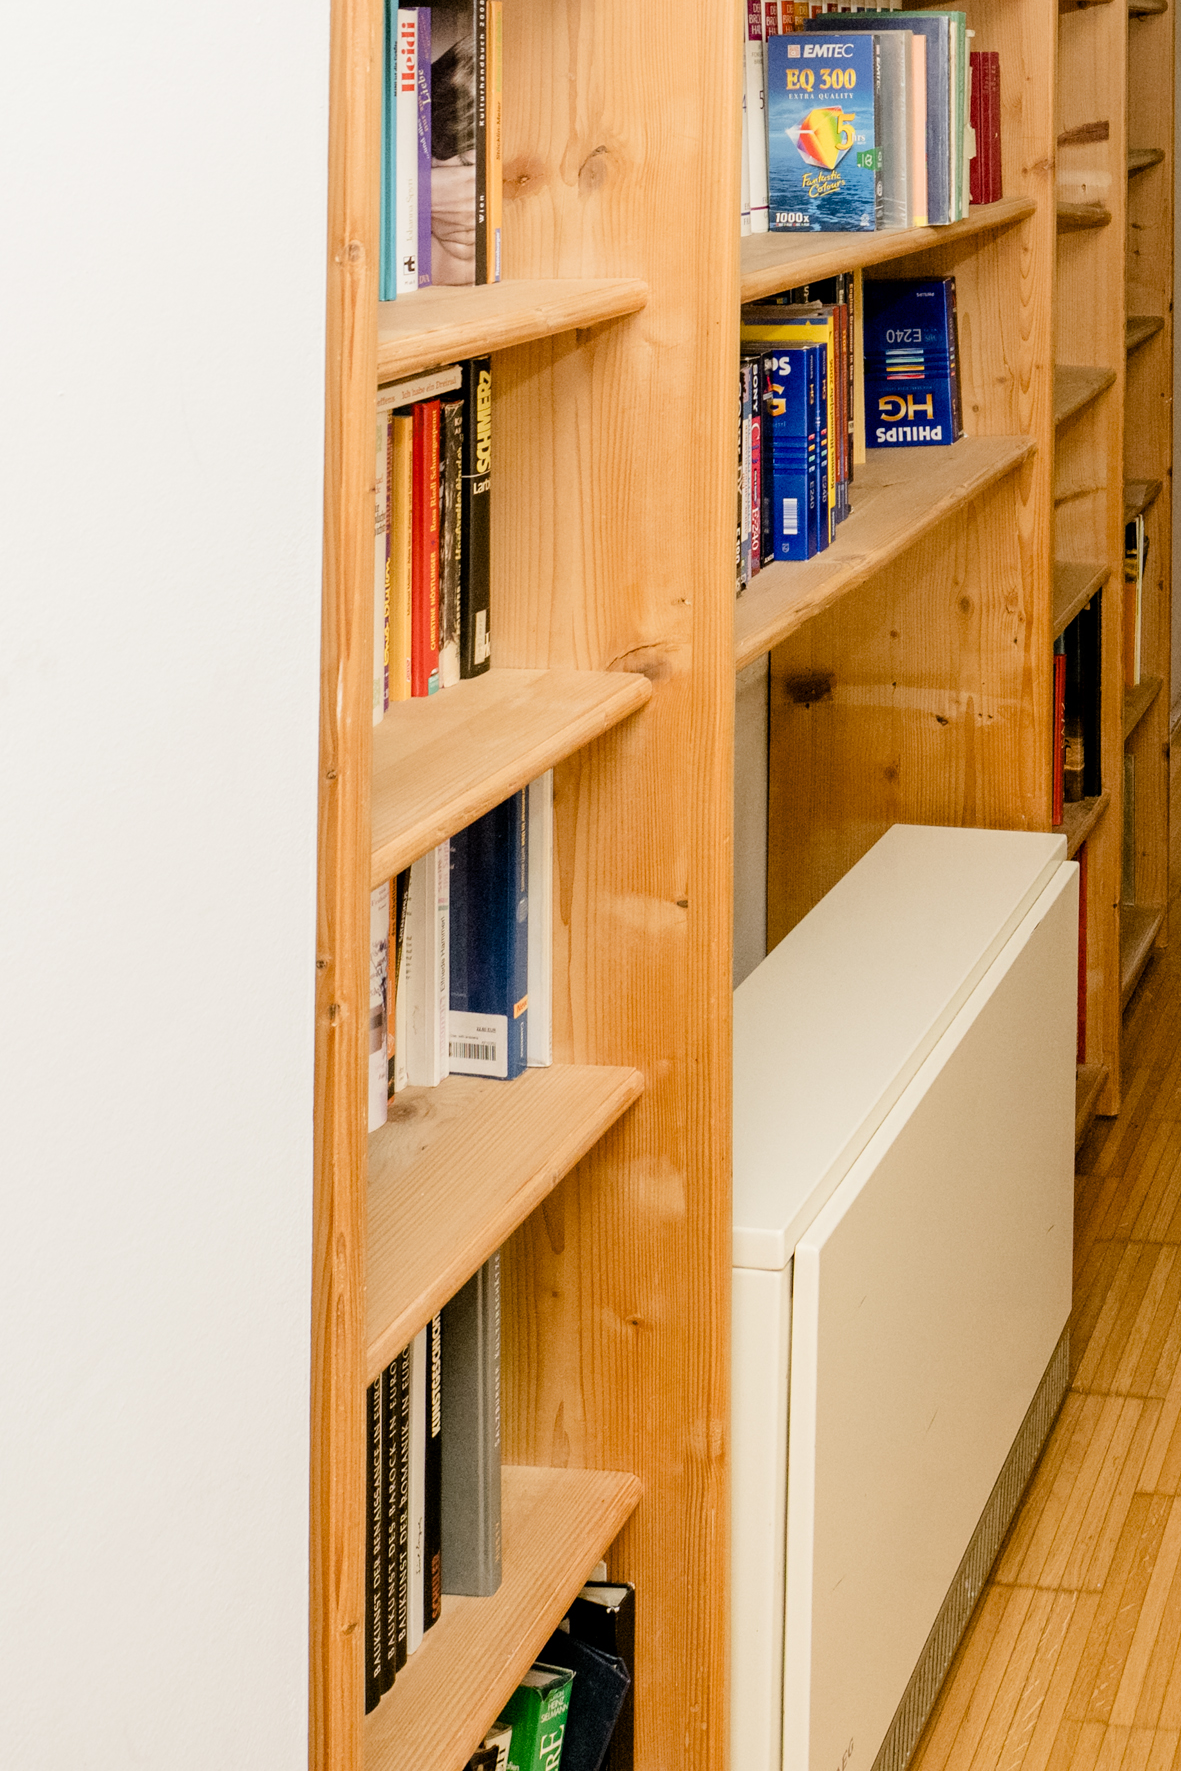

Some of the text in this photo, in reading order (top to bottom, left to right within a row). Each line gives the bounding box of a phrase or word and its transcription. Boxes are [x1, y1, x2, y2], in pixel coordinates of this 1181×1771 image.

[400, 22, 415, 92] Heidi
[803, 44, 854, 58] EMTEC
[418, 69, 431, 105] Liebe
[786, 68, 856, 92] EQ 300
[818, 92, 854, 100] QUALITY
[834, 112, 856, 150] 5
[802, 170, 841, 188] Fantastic
[808, 180, 846, 198] Colours
[776, 212, 810, 223] 1000x
[886, 328, 922, 343] E240
[402, 390, 411, 400] Ich
[426, 383, 435, 392] ein
[435, 376, 457, 389] Dreirad
[476, 370, 491, 473] SCHMERZ
[878, 393, 934, 422] HG
[430, 410, 438, 480] Schutzgespenst
[876, 426, 942, 442] PHILIPS
[400, 1394, 409, 1416] IN
[373, 1423, 380, 1443] IN
[389, 1415, 397, 1438] IN
[388, 1442, 396, 1516] BAROCK
[399, 1422, 409, 1508] ROMANIK
[373, 1449, 382, 1555] RENAISSANCE
[388, 1522, 396, 1558] DES
[399, 1510, 408, 1545] DER
[373, 1556, 381, 1590] DER
[388, 1562, 396, 1660] BAUKUNST
[398, 1552, 408, 1642] BAUKUNST
[373, 1593, 382, 1678] BAUKUNST
